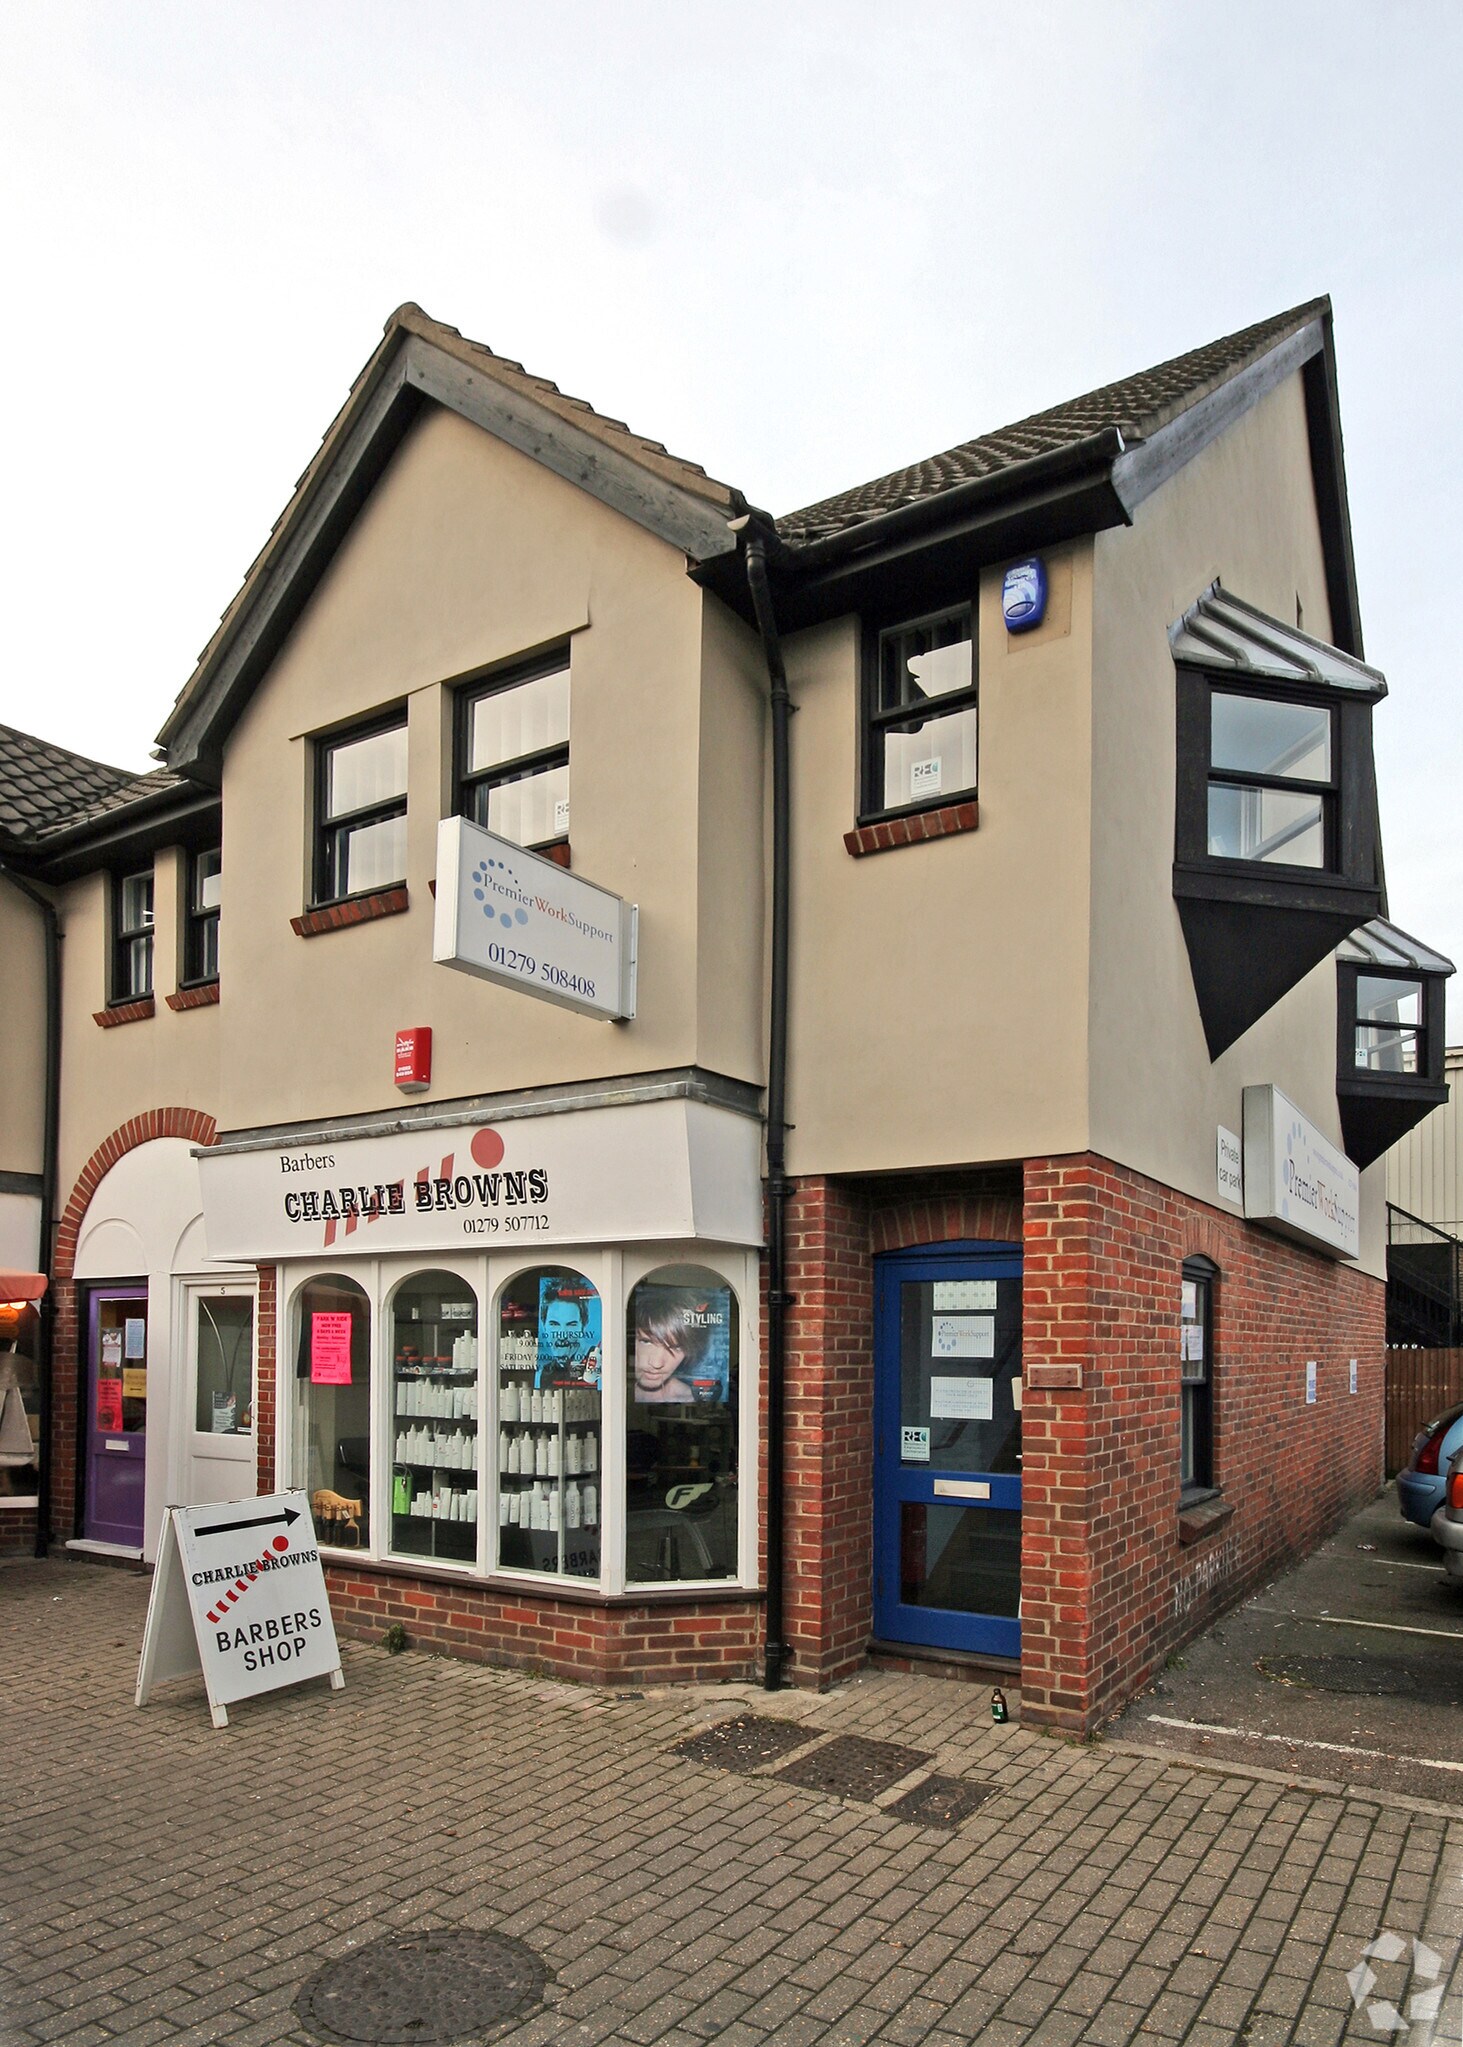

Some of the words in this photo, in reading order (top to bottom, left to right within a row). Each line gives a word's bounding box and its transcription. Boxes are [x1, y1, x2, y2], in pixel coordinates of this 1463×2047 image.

[483, 873, 613, 943] PremierWorkSupport
[488, 942, 536, 975] 01279
[540, 963, 596, 998] 508408
[280, 1152, 336, 1175] Barbers
[1220, 1138, 1240, 1165] Private
[1218, 1167, 1229, 1184] car
[284, 1182, 406, 1223] CHARLIE
[413, 1168, 549, 1210] BROWNS
[463, 1218, 499, 1235] 01279
[504, 1213, 551, 1233] 507712
[683, 1312, 723, 1324] STYLING
[551, 1330, 595, 1339] THURSDAY
[504, 1353, 533, 1361] FRIDAY
[192, 1562, 258, 1586] CHARLIE
[262, 1550, 318, 1572] BROWNS
[216, 1607, 322, 1653] BARBERS
[244, 1637, 307, 1672] SHOP
